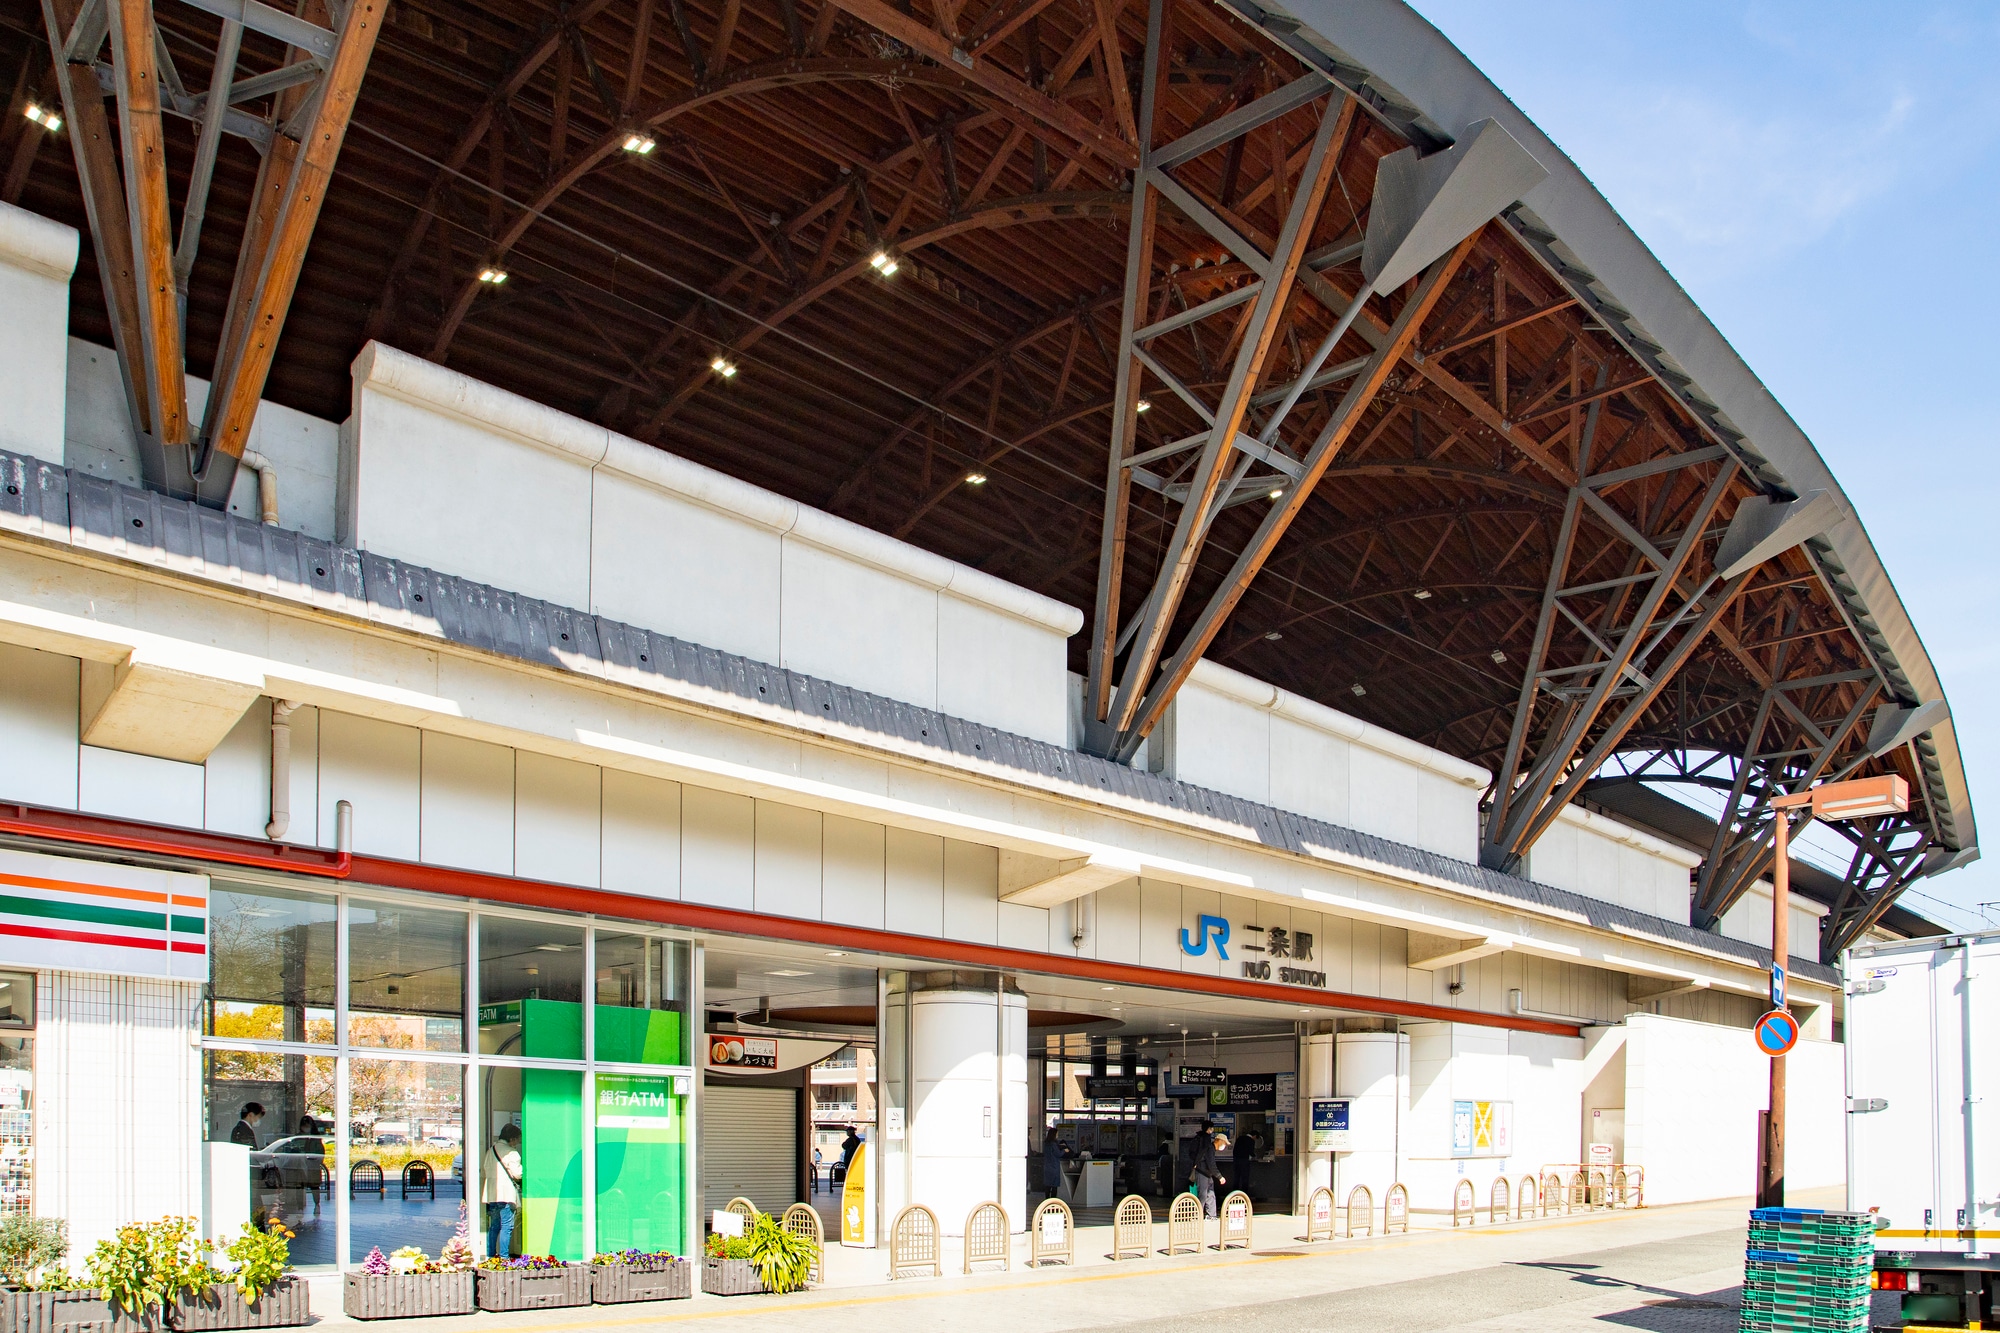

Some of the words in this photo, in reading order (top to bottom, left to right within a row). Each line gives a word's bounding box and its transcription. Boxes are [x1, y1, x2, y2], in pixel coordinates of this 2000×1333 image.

[1180, 913, 1230, 960] JR
[1242, 924, 1314, 962] 二条駅
[1279, 966, 1327, 988] STATION
[599, 1089, 665, 1107] 銀行ATM
[1230, 1083, 1273, 1092] きっぷうりば
